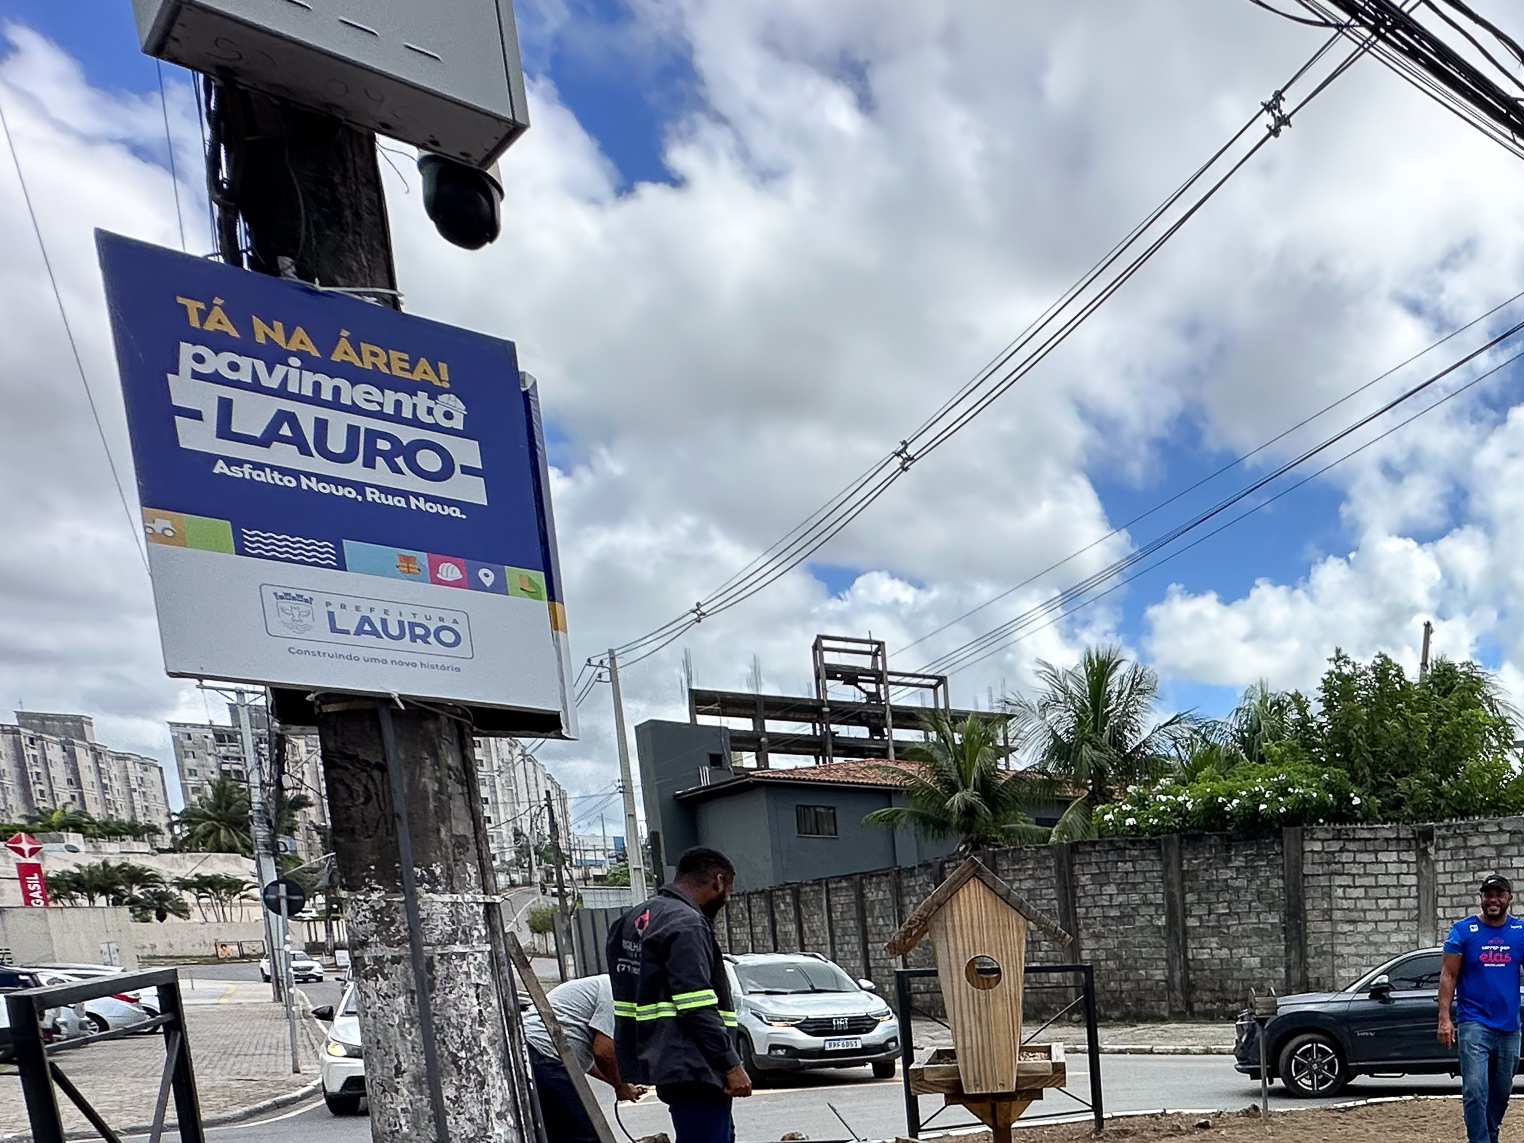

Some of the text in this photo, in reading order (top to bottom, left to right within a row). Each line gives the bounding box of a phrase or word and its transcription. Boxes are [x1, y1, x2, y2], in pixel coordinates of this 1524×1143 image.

[175, 296, 450, 388] TÁ NA ÁREA!
[179, 340, 466, 431] pavimenta
[216, 394, 456, 483] LAURO
[212, 458, 298, 488] Asfalto
[364, 485, 408, 509] Rua
[325, 600, 460, 625] PREFEITURA
[326, 610, 462, 649] LAURO
[288, 646, 462, 673] Construindo uma nova história
